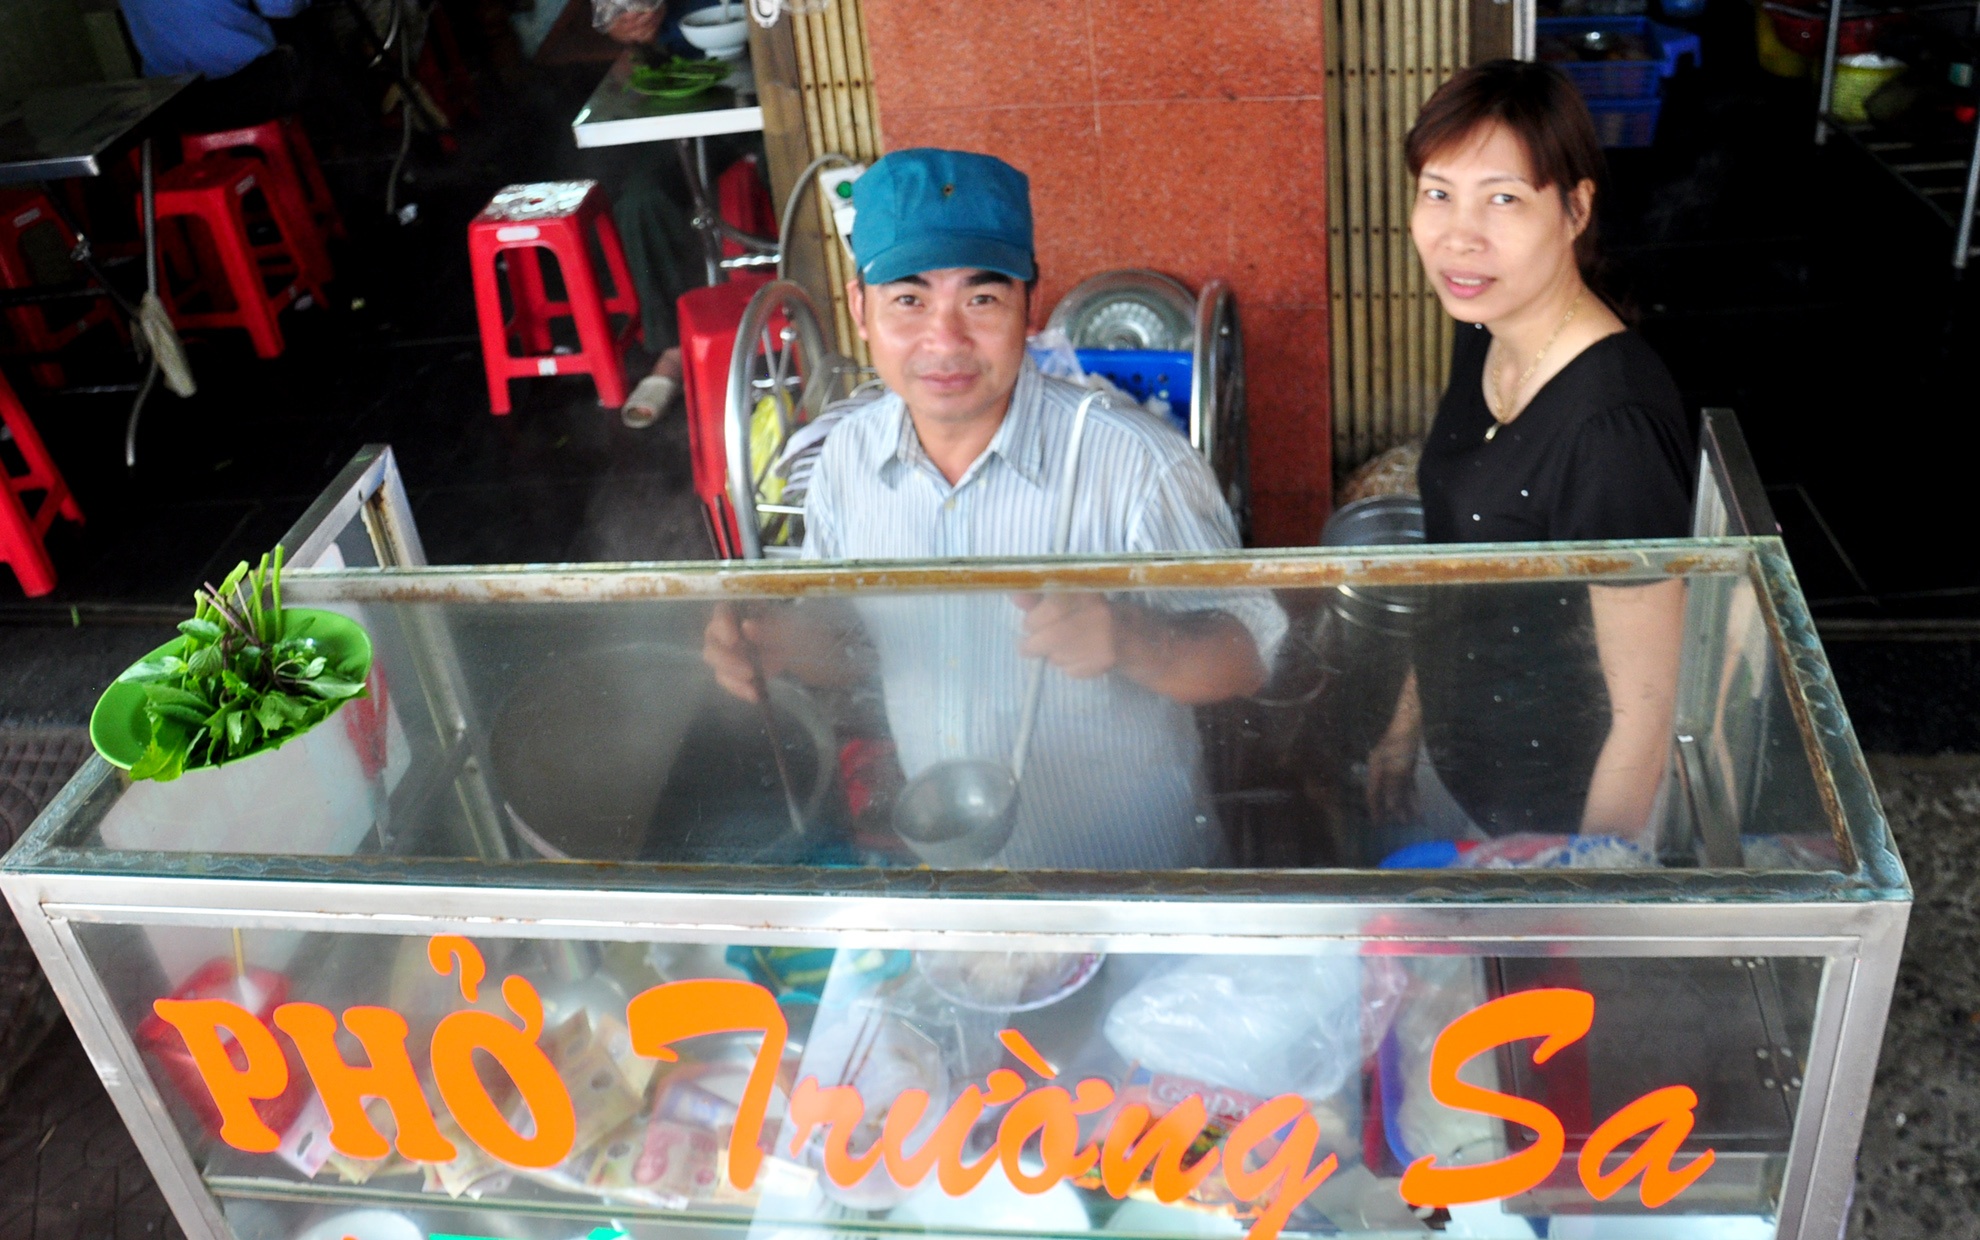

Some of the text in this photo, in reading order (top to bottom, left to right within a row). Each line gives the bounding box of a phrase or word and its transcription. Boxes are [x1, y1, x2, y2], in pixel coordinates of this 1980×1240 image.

[153, 935, 1716, 1240] PHỞ Trường Sa
